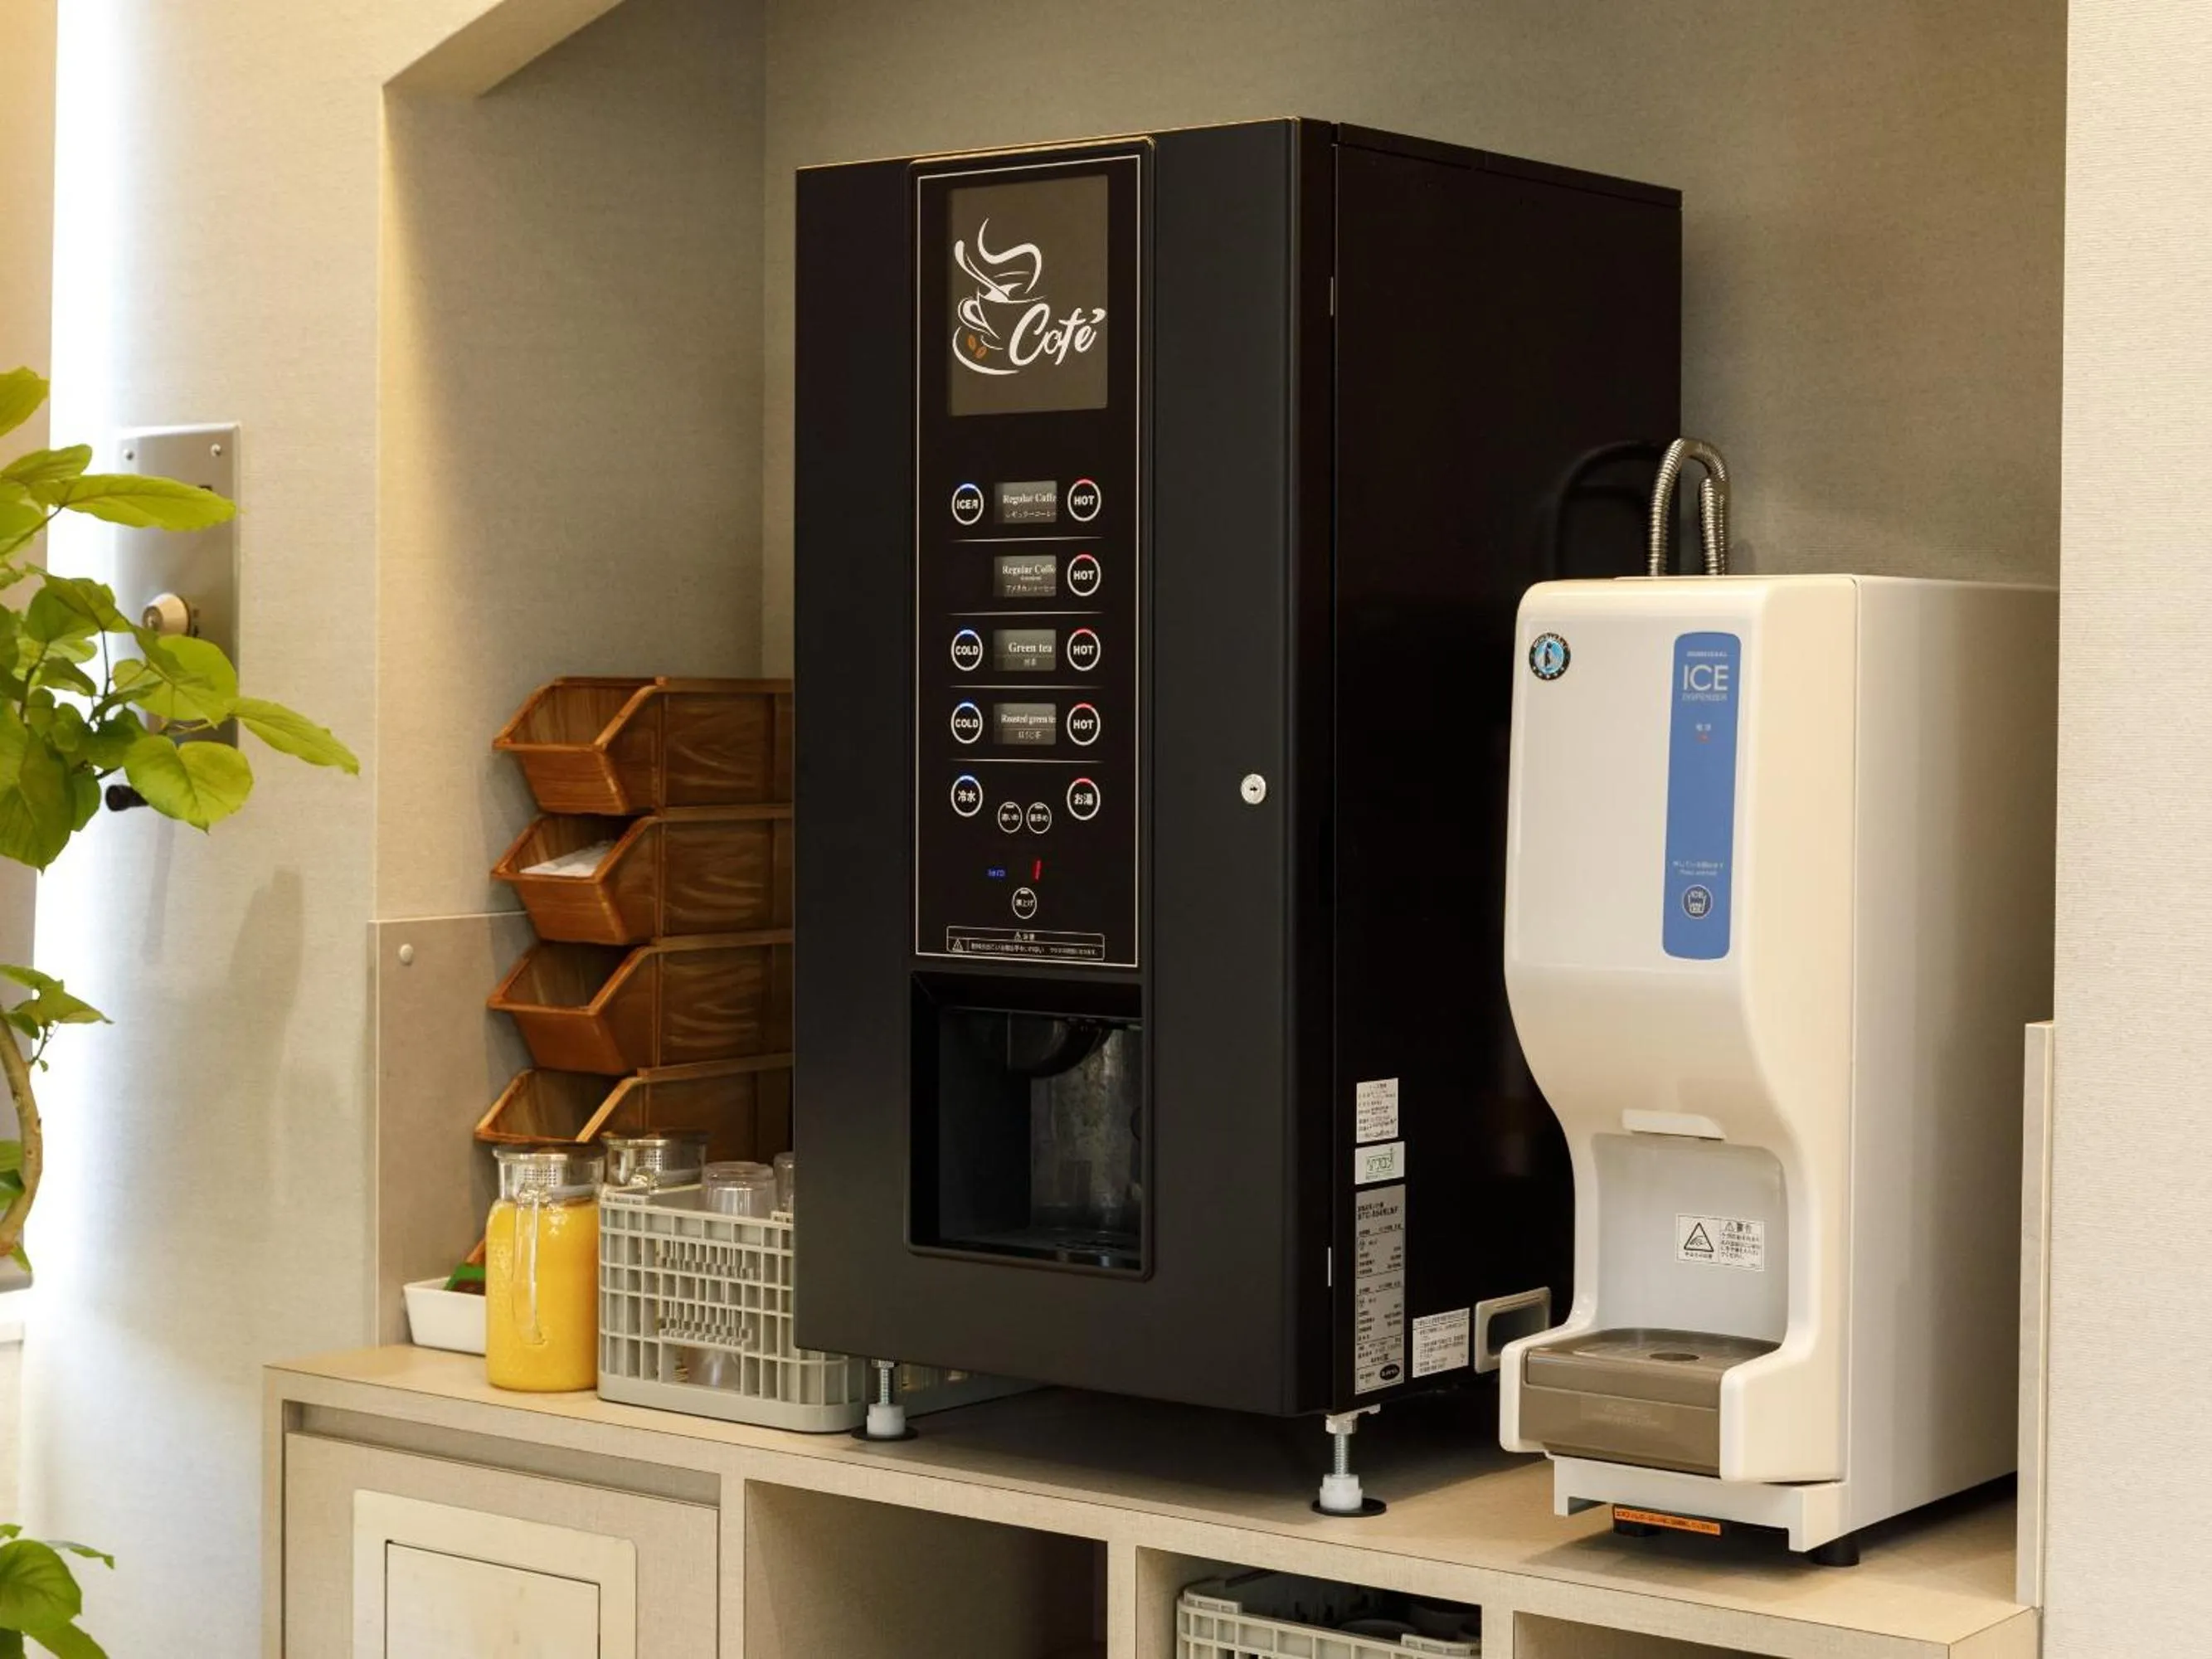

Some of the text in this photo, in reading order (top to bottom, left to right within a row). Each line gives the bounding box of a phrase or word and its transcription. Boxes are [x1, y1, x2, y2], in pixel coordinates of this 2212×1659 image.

[1074, 495, 1095, 506] HOT
[1002, 565, 1033, 576] Regular
[1073, 571, 1095, 580] HOT
[955, 645, 979, 655] COLD
[1008, 642, 1053, 653] Green tea
[1073, 645, 1095, 655] HOT
[1684, 664, 1729, 692] ICE
[955, 719, 979, 728] COLD
[1073, 720, 1094, 730] HOT
[958, 790, 976, 803] 冷水
